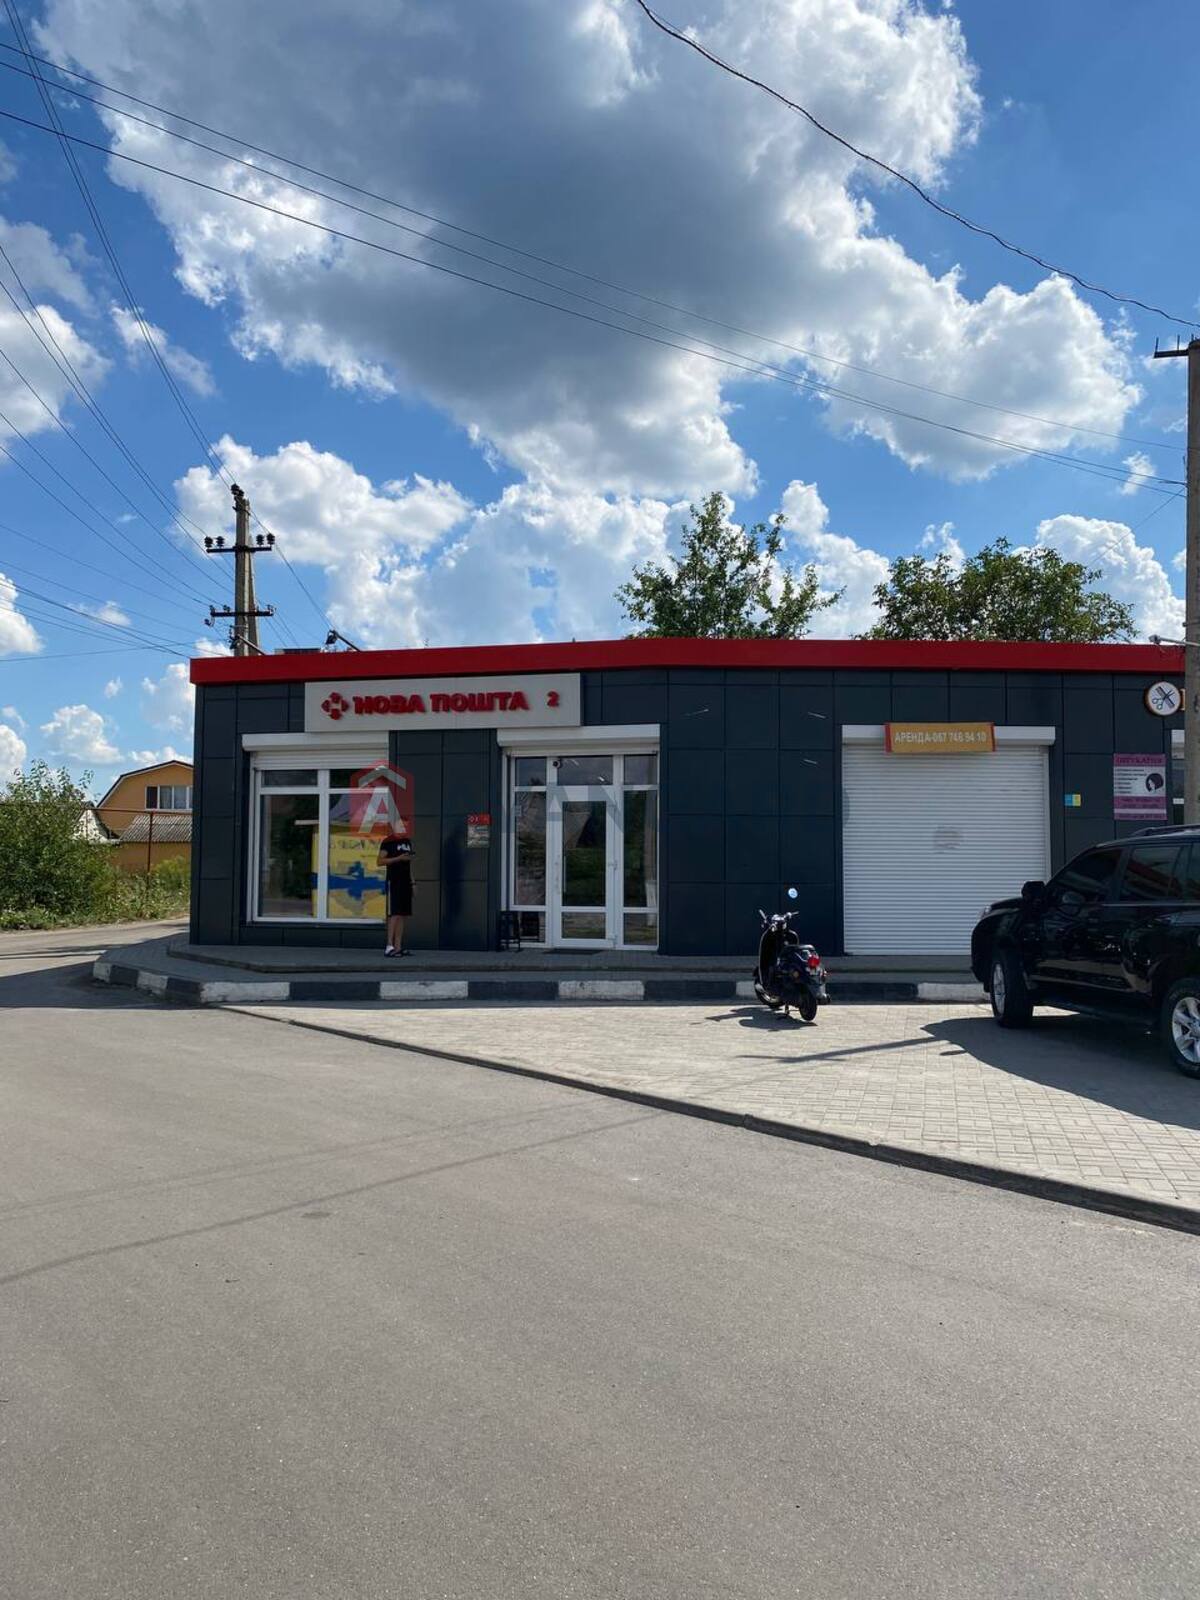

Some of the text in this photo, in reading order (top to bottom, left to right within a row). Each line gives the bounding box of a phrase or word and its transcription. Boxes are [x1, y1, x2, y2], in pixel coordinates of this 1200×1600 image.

[353, 691, 560, 715] НОВА ПОШТА 2
